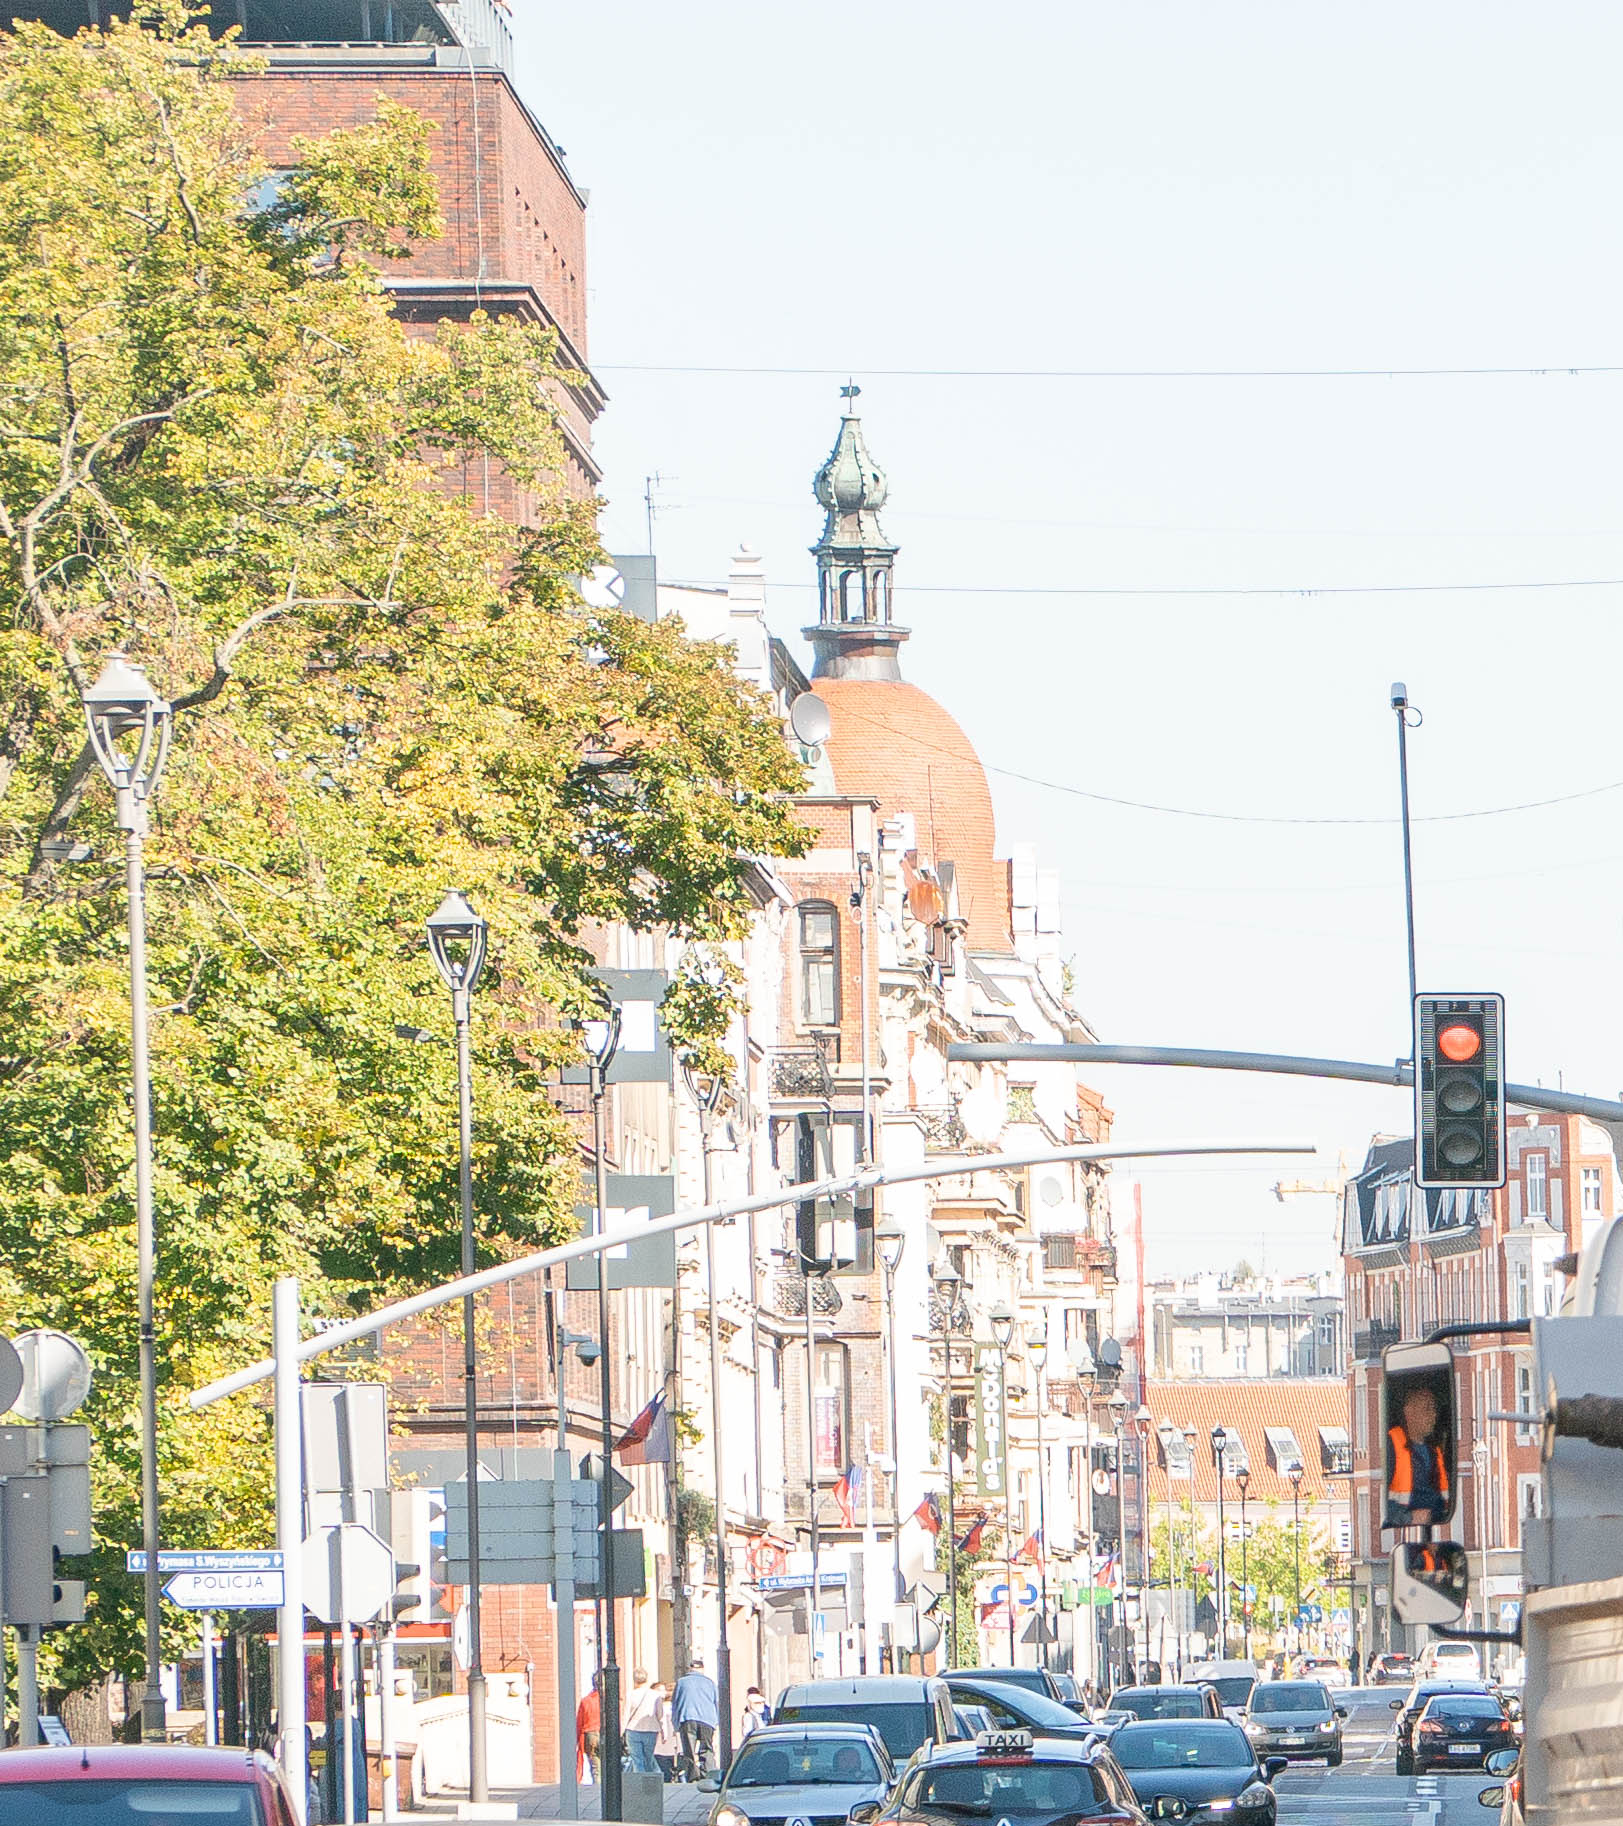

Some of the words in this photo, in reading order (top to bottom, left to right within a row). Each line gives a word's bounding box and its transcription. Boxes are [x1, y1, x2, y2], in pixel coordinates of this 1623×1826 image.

[969, 1348, 1004, 1491] McDonald's
[193, 1576, 265, 1589] POLICJA
[984, 1734, 1025, 1746] TAXI
